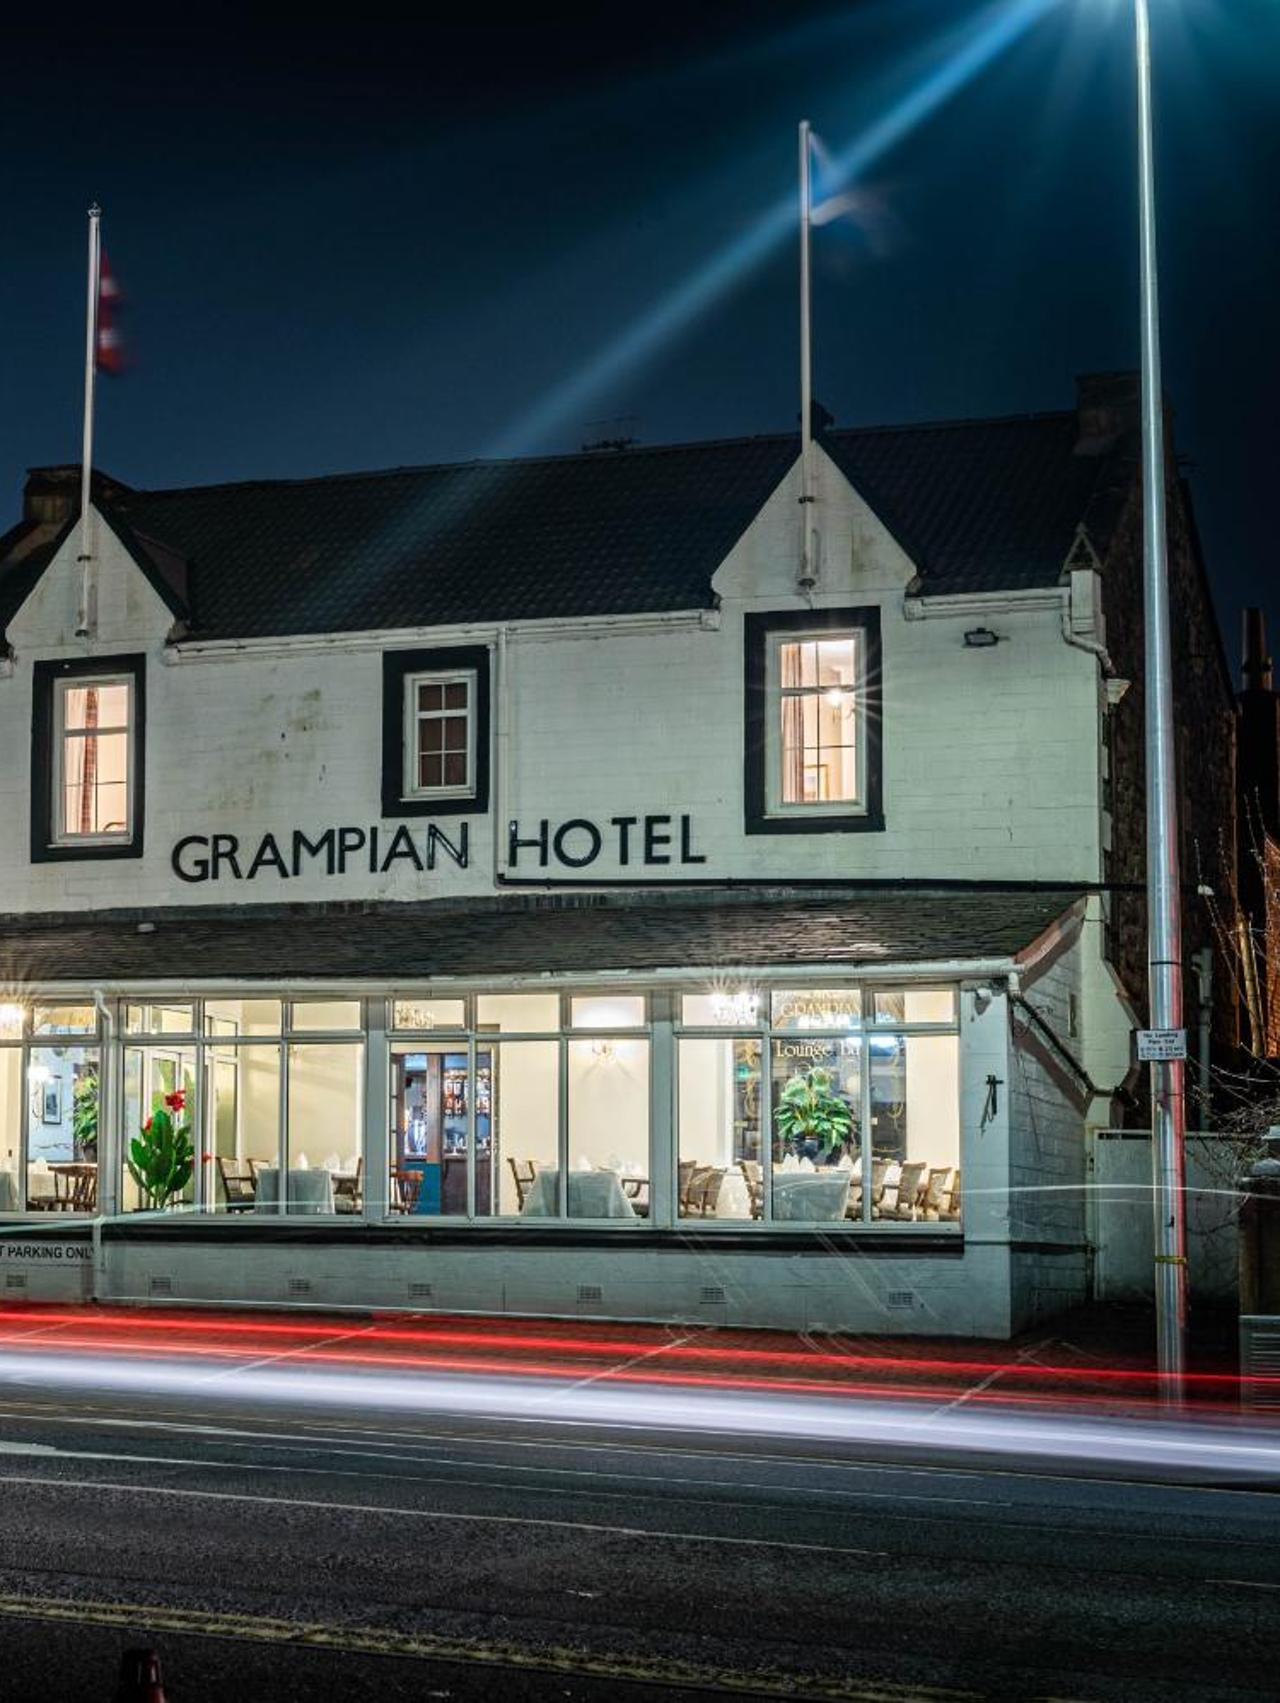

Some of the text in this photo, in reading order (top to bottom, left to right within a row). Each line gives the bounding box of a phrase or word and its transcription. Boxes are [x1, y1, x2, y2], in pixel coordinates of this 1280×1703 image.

[171, 815, 707, 883] GRAMPIAN HOTEL
[776, 1039, 834, 1063] Lounge
[8, 1246, 62, 1259] PARKING
